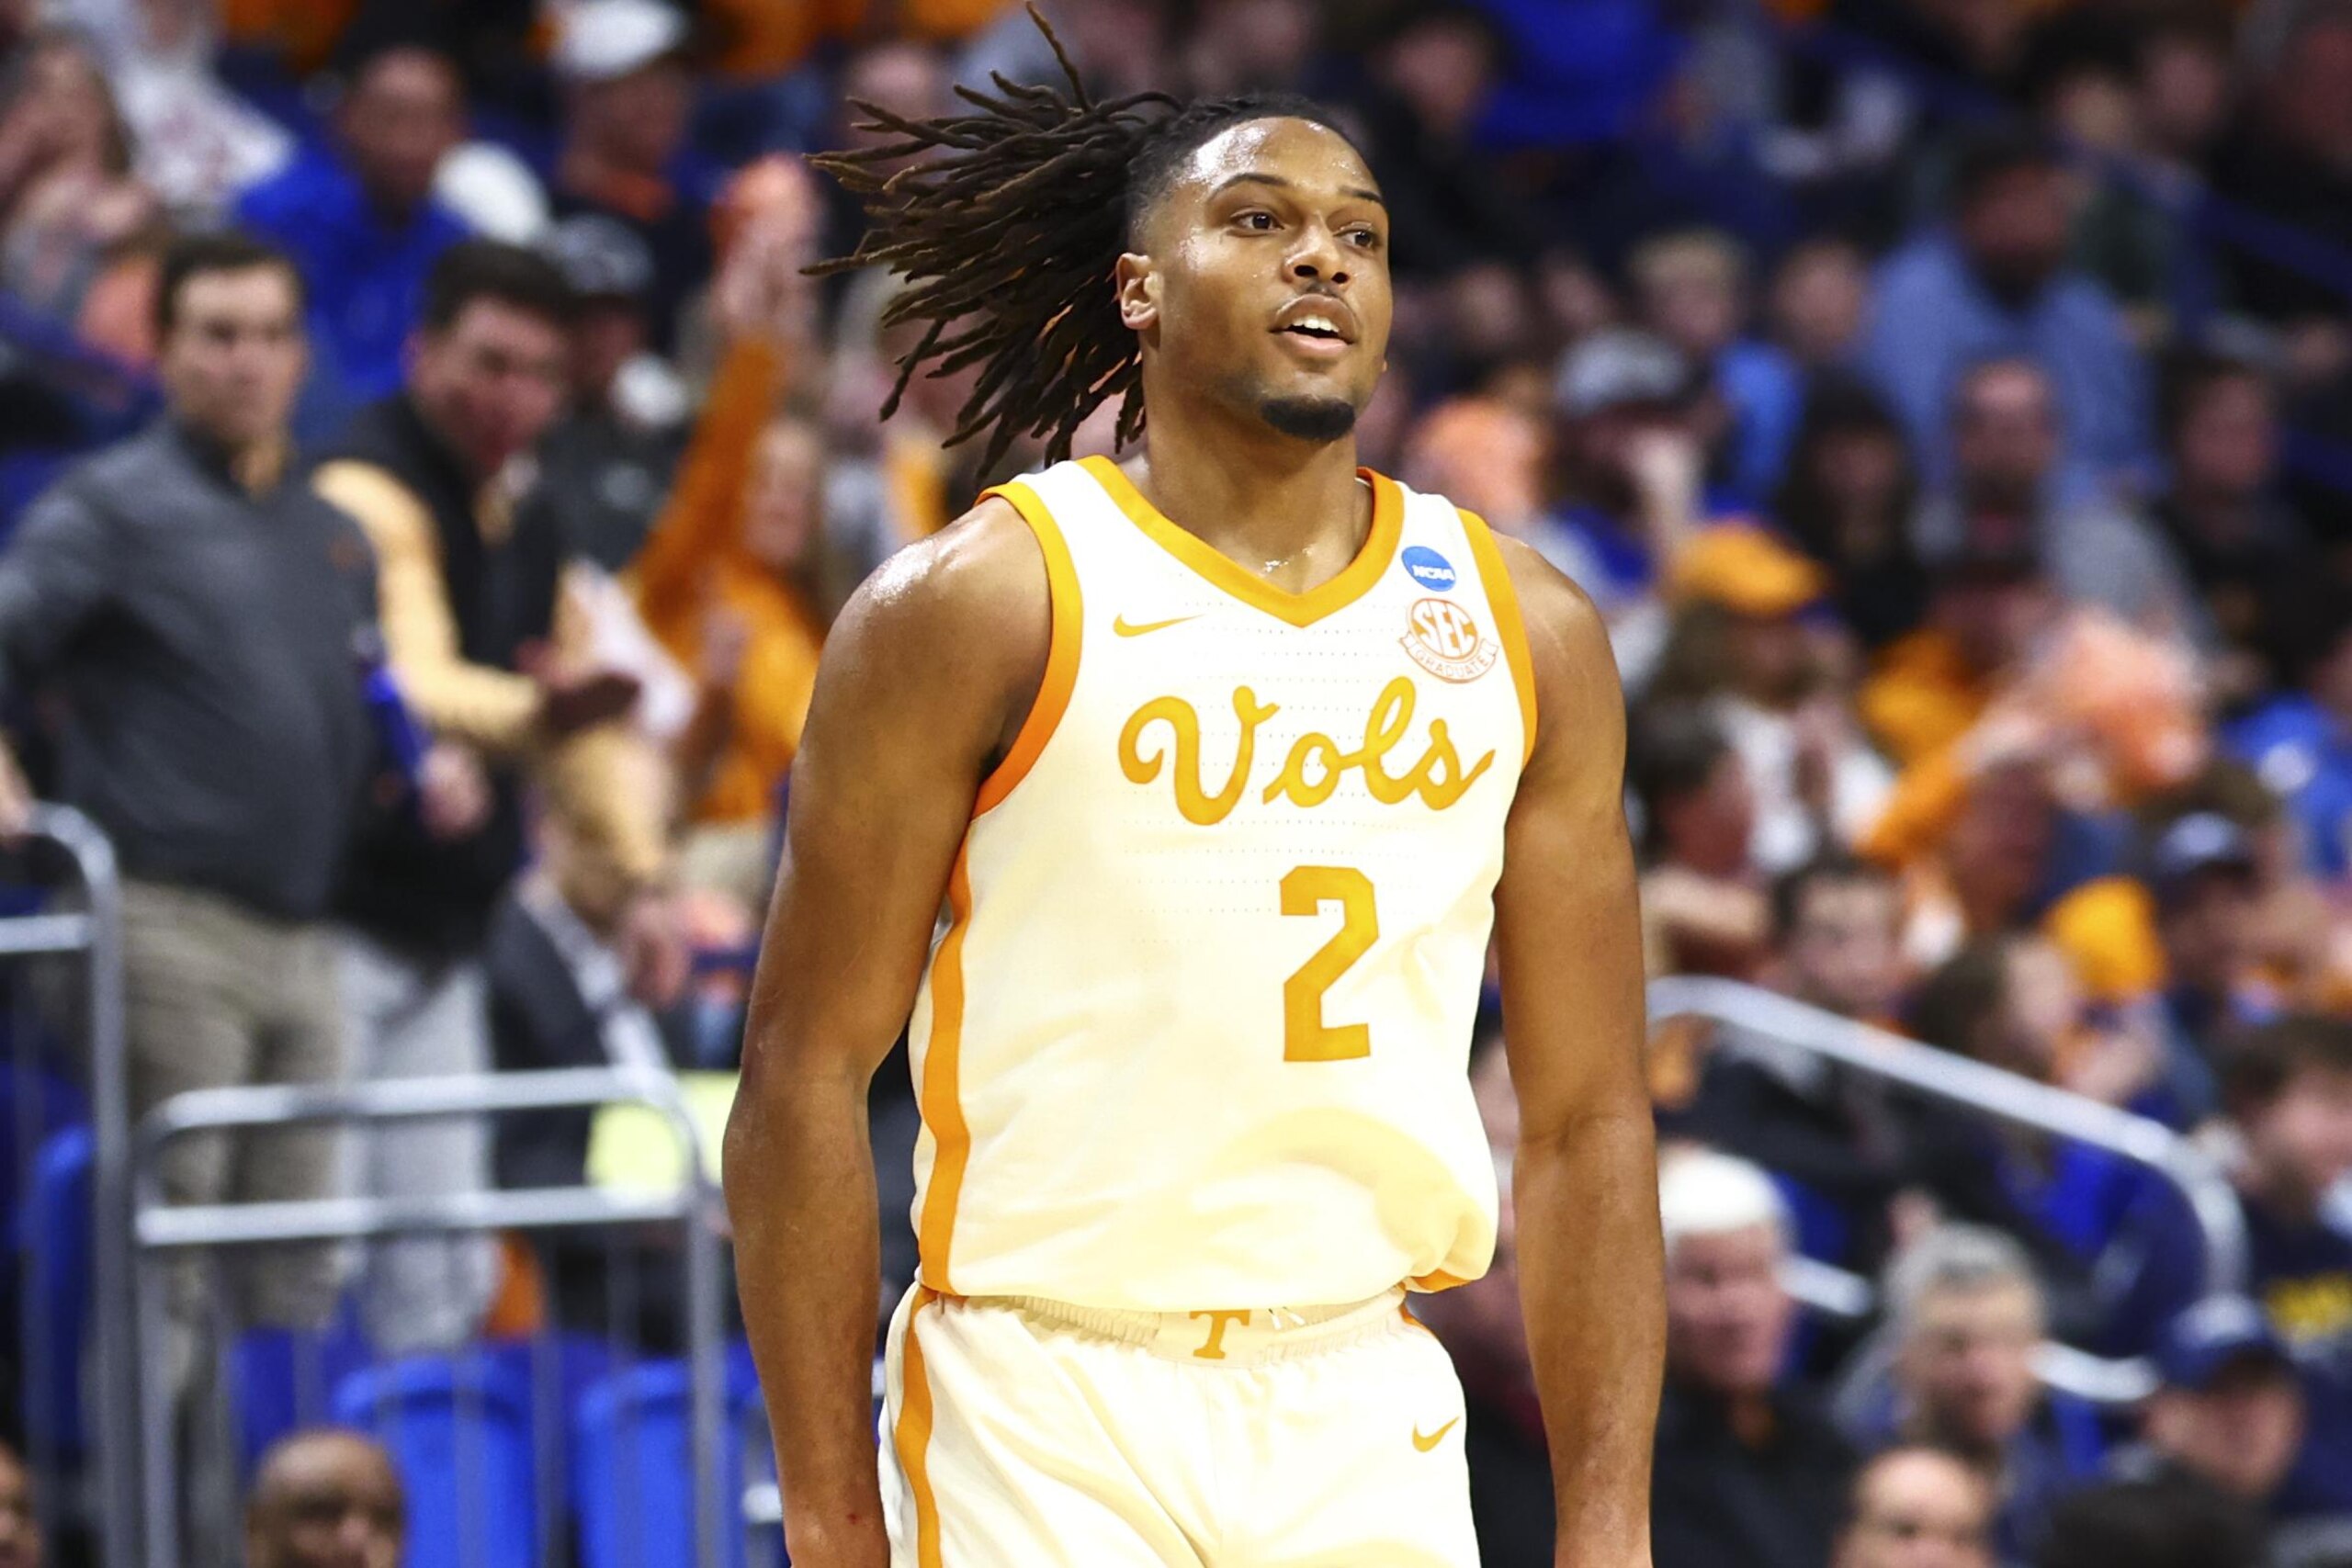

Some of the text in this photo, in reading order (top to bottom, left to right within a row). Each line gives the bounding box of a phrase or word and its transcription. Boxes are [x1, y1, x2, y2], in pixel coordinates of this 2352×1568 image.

[1412, 564, 1455, 581] NCAA
[1414, 600, 1476, 658] SEC
[1416, 649, 1488, 676] GRADUATE
[1118, 676, 1496, 826] Vols
[1280, 865, 1379, 1062] 2
[1189, 1309, 1251, 1359] T
